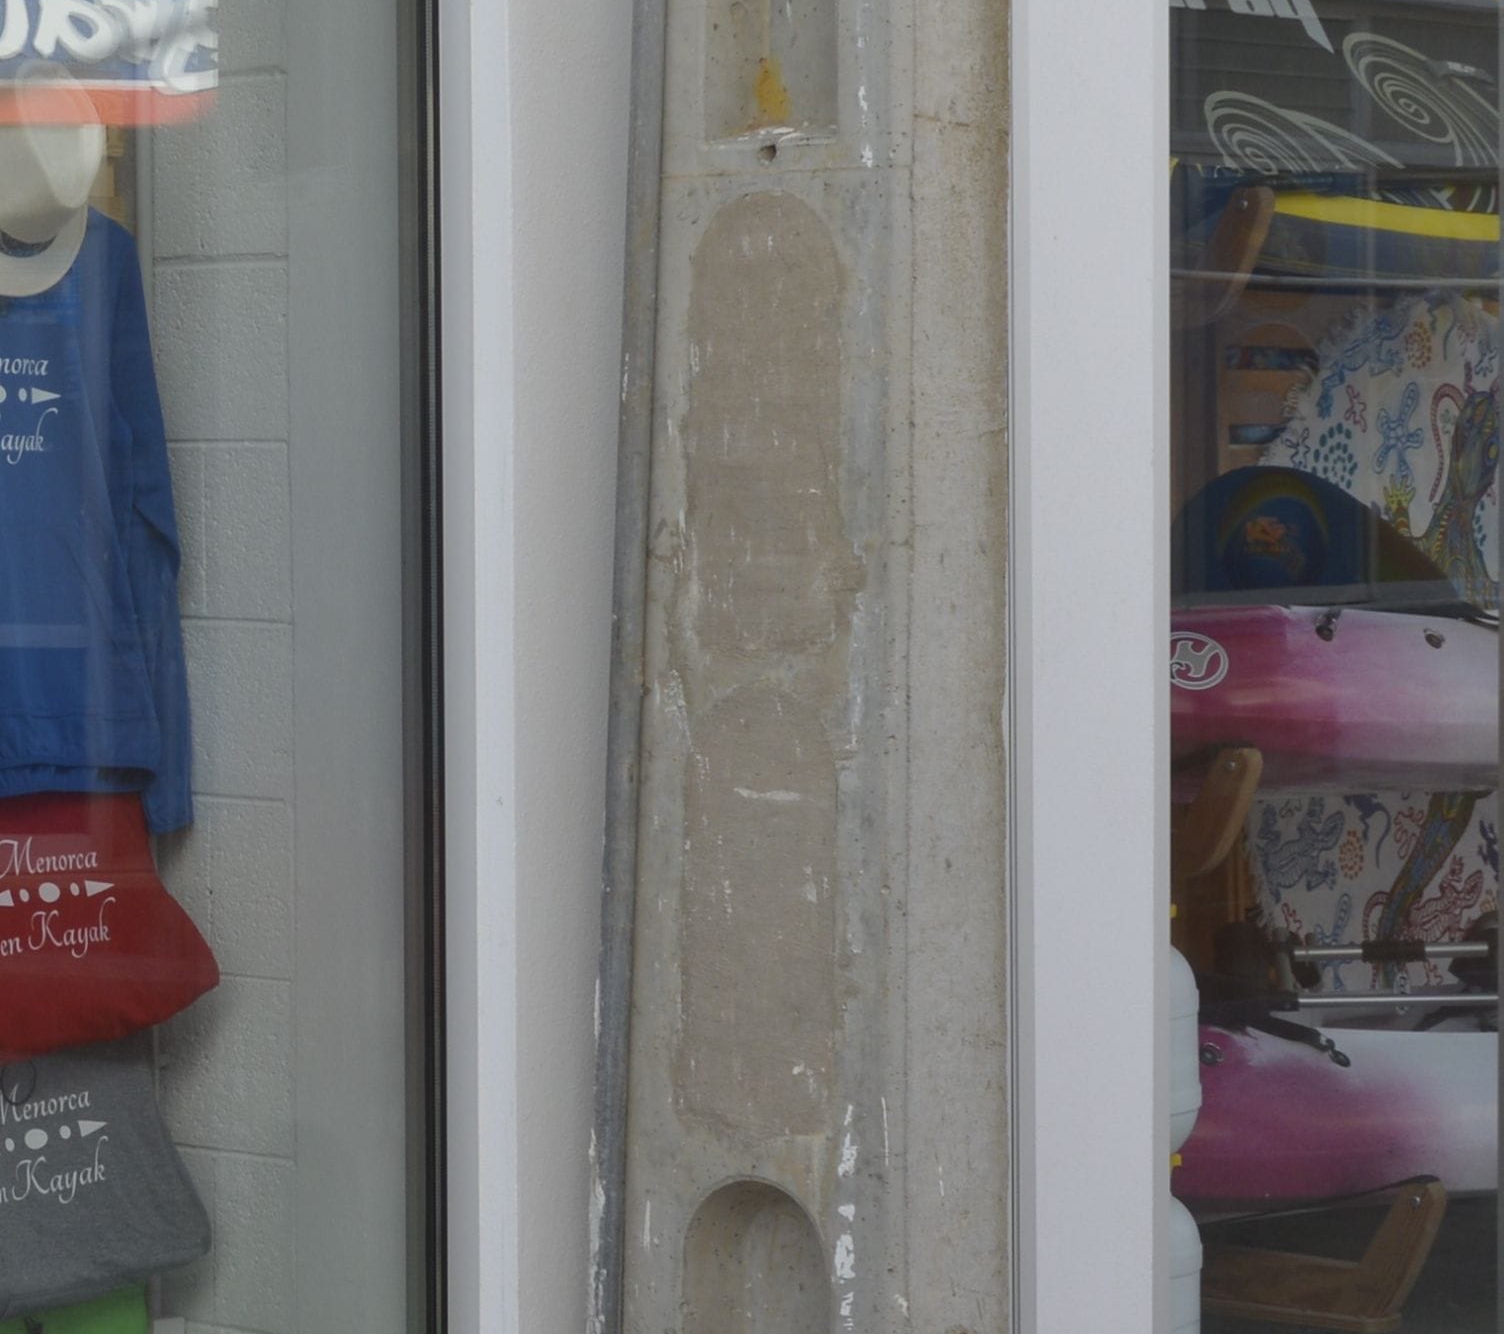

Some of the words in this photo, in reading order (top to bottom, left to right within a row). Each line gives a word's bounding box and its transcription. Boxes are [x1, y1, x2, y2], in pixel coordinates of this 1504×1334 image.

[0, 937, 23, 956] en
[28, 897, 116, 958] Kayak
[12, 1135, 109, 1204] Kayak
